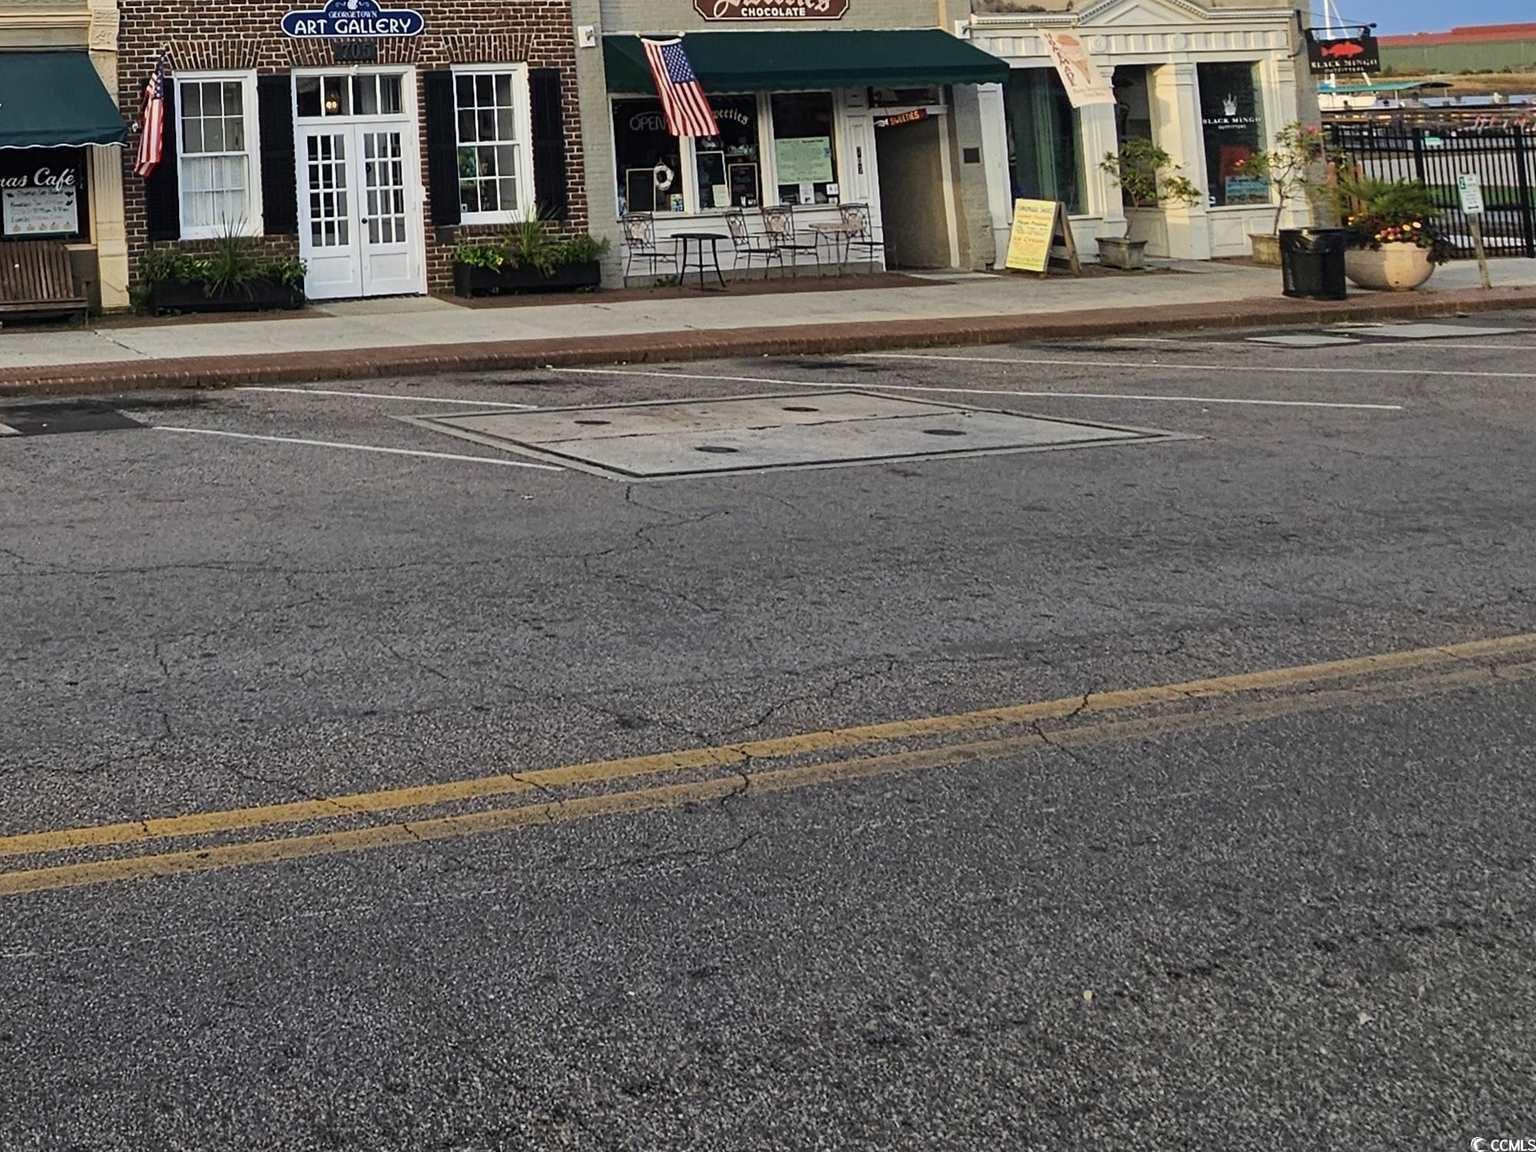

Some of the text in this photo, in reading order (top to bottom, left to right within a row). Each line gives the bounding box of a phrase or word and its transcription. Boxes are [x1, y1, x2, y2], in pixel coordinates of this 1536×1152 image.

[328, 11, 378, 19] GEORGETOWN
[741, 7, 806, 17] CHOCOLATE
[294, 18, 412, 35] ART GALLERY
[33, 167, 76, 191] Café
